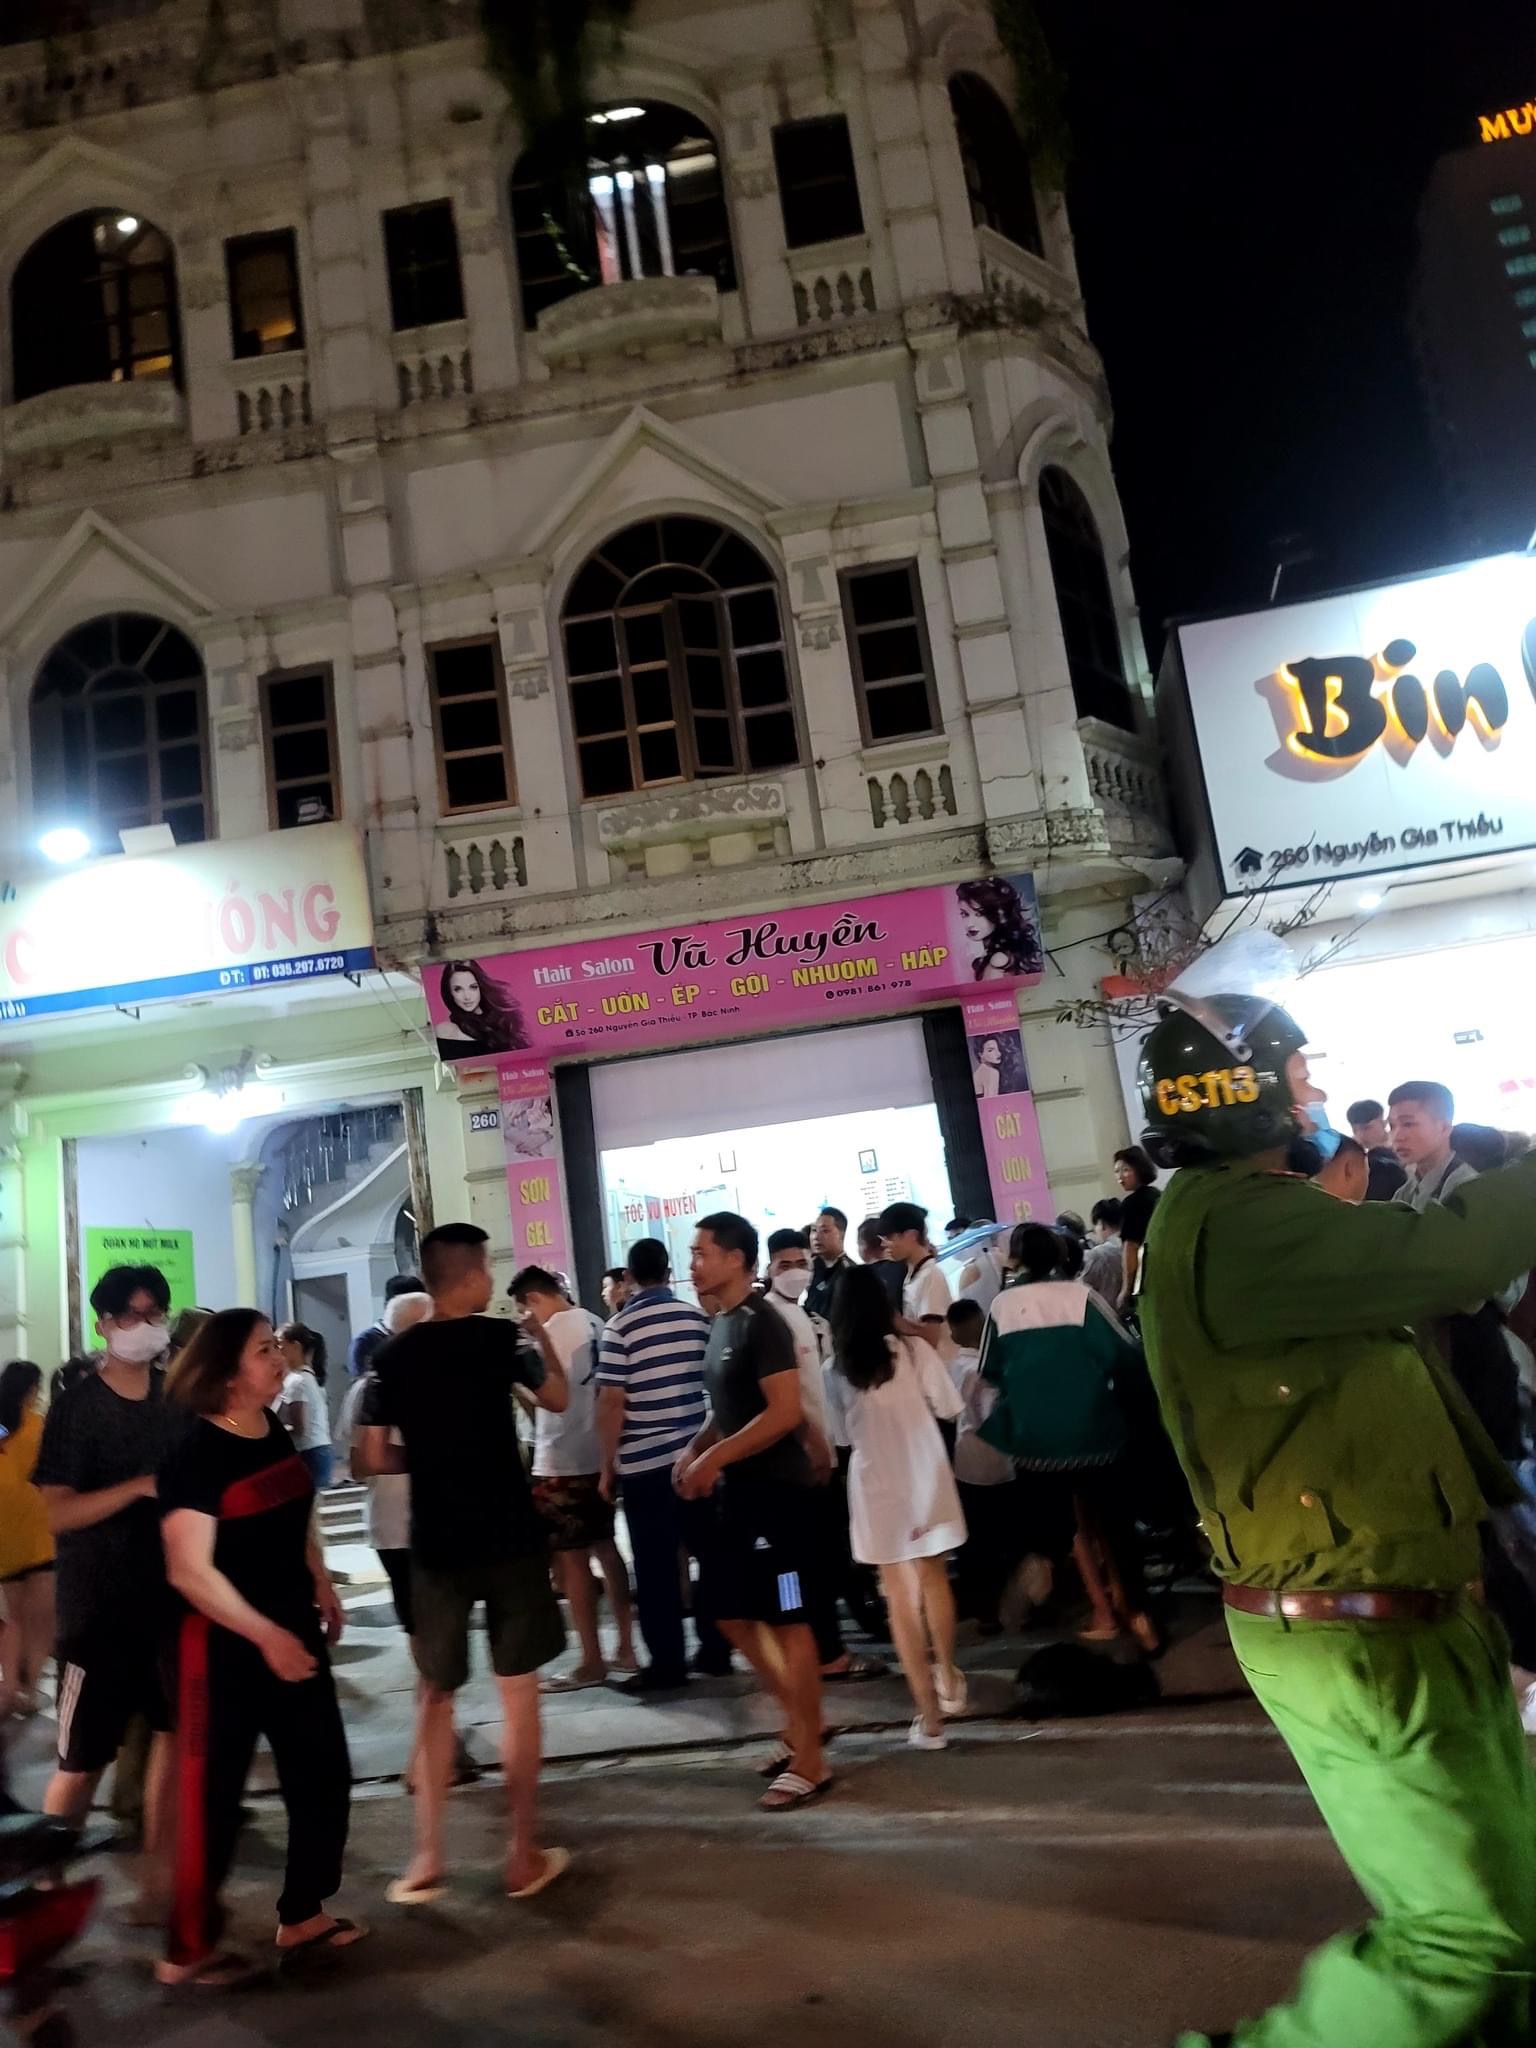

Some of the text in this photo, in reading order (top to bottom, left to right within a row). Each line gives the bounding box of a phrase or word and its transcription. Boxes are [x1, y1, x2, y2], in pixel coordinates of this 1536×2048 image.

[1280, 638, 1508, 760] Bin
[1272, 846, 1309, 868] 260
[1400, 828, 1438, 848] Gia
[533, 913, 887, 986] Hair Salon Vũ Huyền
[536, 998, 579, 1026] CẮT
[601, 987, 650, 1016] UỐN
[671, 983, 700, 1006] ÉP
[730, 972, 769, 998] GỘI
[792, 957, 878, 988] NHUỘM
[901, 941, 948, 971] HẤP
[1156, 1065, 1259, 1115] CS113
[471, 1113, 497, 1129] 260
